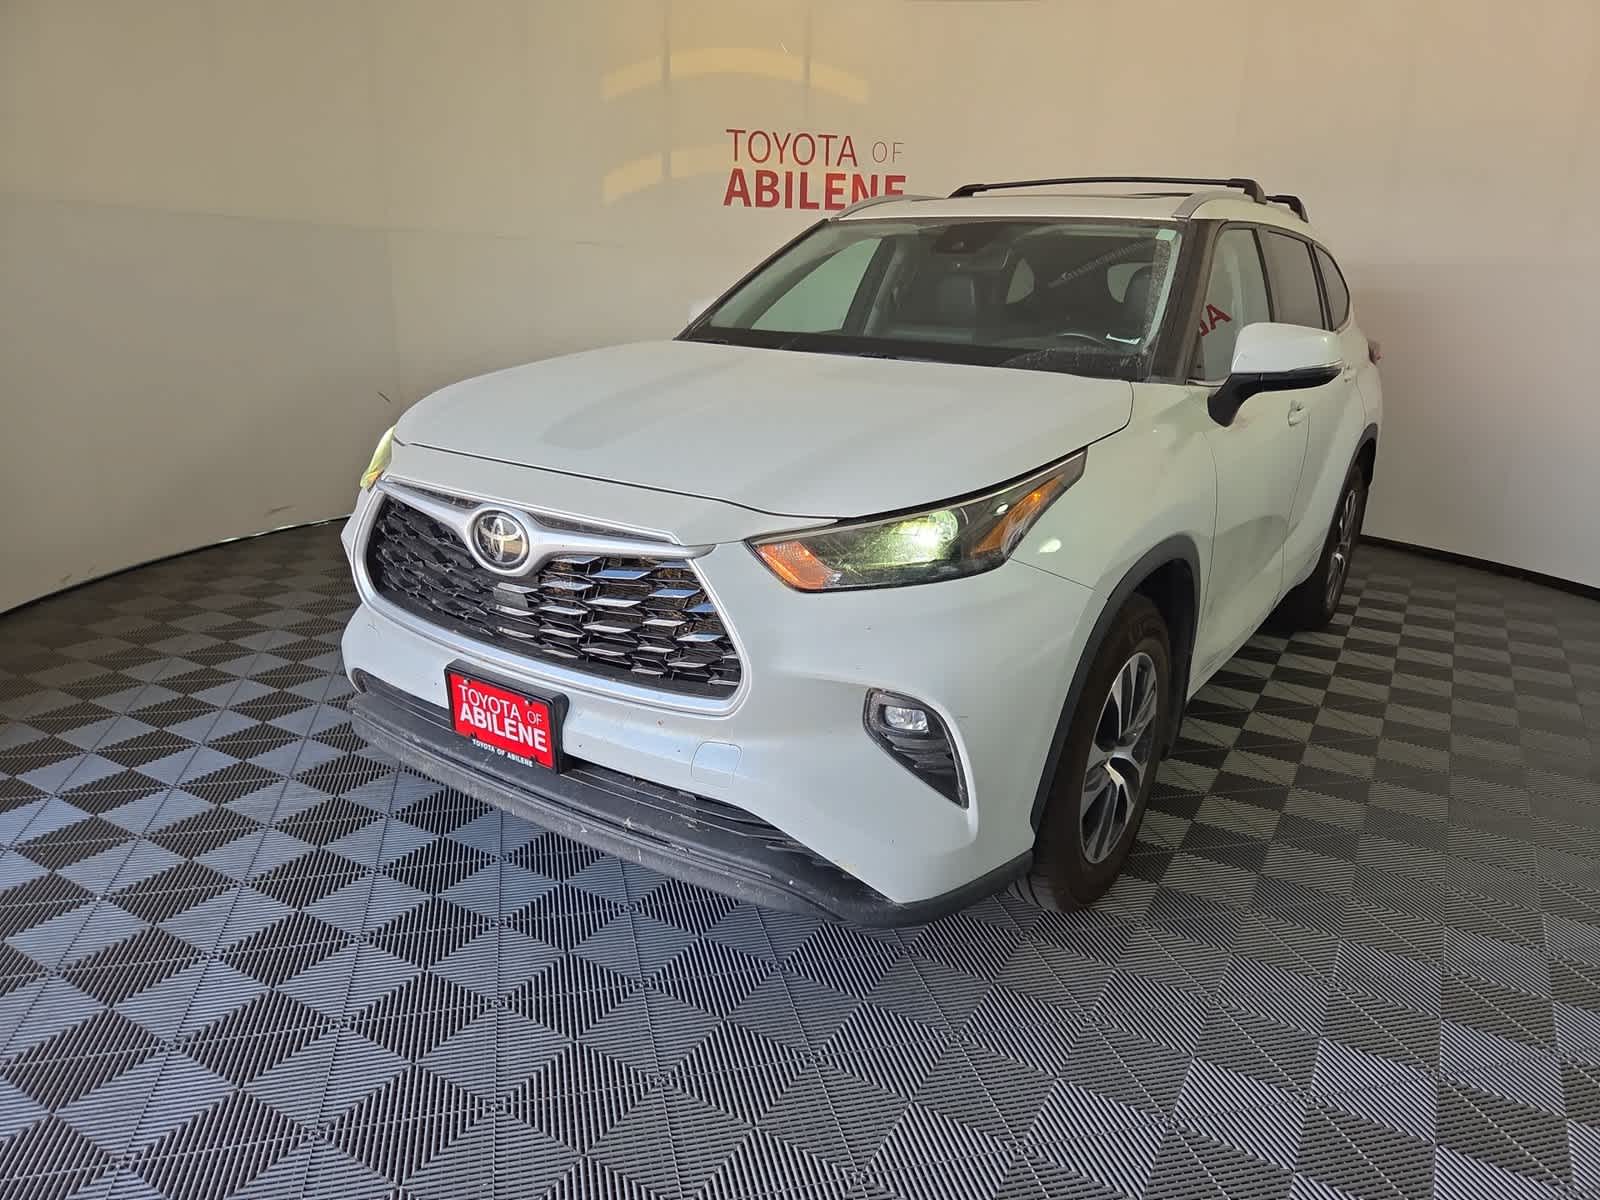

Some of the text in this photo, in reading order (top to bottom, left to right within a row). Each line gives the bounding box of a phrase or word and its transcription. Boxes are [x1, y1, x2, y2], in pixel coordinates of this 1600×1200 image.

[726, 129, 905, 167] TOYOTA OF
[458, 684, 542, 725] TOYOTA OF
[460, 703, 547, 752] ABILENE
[472, 739, 533, 768] TOYOTA OF ABILENE
